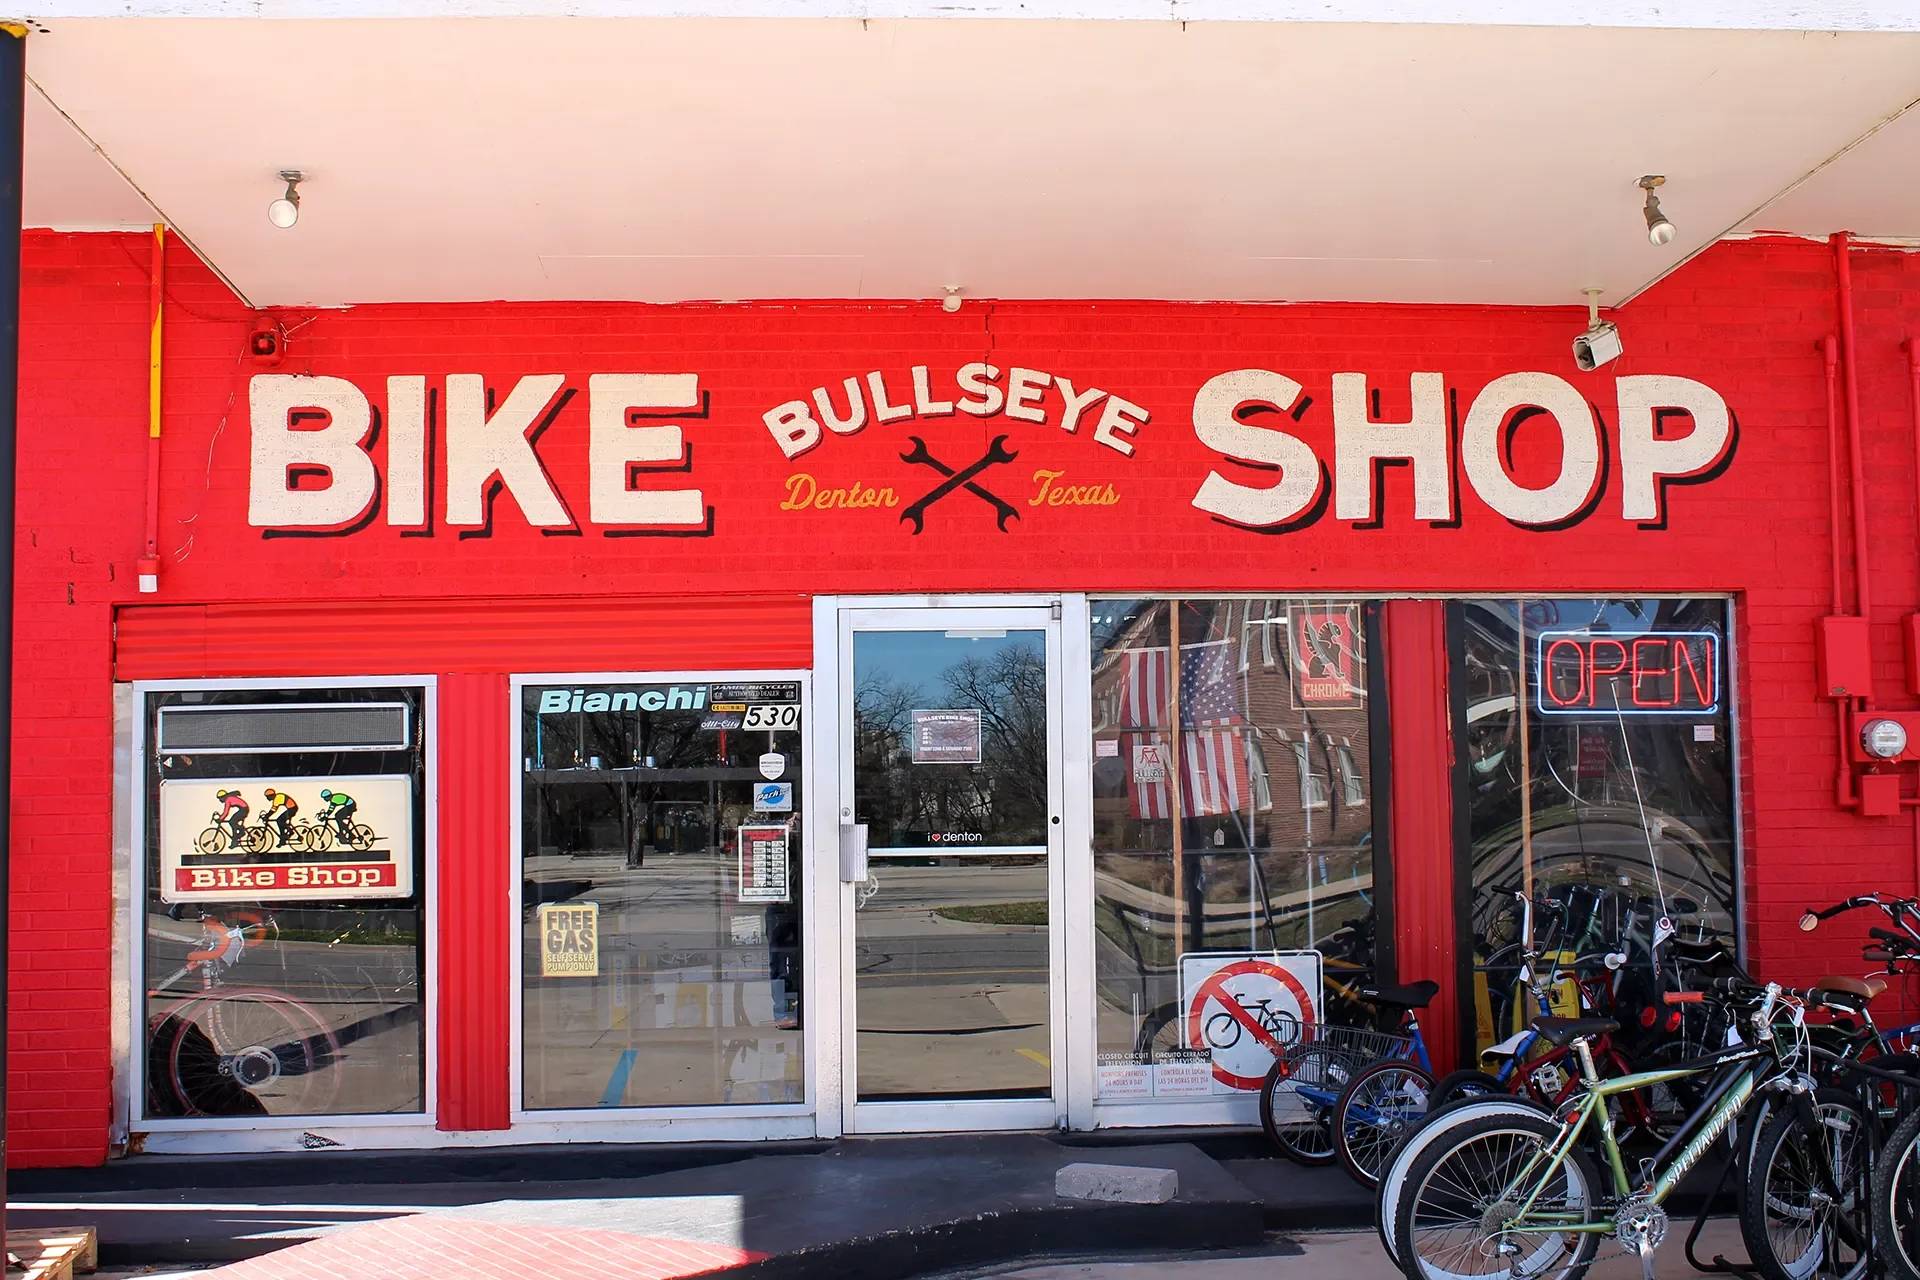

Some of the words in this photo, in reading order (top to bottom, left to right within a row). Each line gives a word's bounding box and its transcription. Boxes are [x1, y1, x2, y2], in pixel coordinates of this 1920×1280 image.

[762, 362, 1152, 461] BULLSEYE
[248, 373, 714, 538] BIKE
[1192, 369, 1740, 534] SHOP
[780, 473, 900, 511] Denton
[1028, 470, 1121, 507] Texas
[1546, 639, 1713, 707] OPEN
[538, 686, 708, 714] Bianchi
[1303, 683, 1350, 698] CHROME
[701, 719, 740, 730] All-City
[746, 706, 796, 727] 530
[918, 715, 945, 723] BULLSEYE
[756, 789, 781, 803] Park
[927, 832, 931, 842] i
[942, 831, 983, 842] denton
[191, 868, 276, 888] Bike
[287, 865, 381, 888] Shop
[547, 911, 594, 930] FREE
[547, 930, 594, 953] GAS
[568, 951, 595, 962] SERVE
[547, 962, 571, 972] PUMP
[573, 962, 595, 971] ONLY
[1124, 1052, 1149, 1060] CIRCUIT
[1155, 1051, 1182, 1059] CIRCUITO
[1182, 1050, 1210, 1058] CERRADO
[1666, 1093, 1742, 1186] SPECIALIZED
